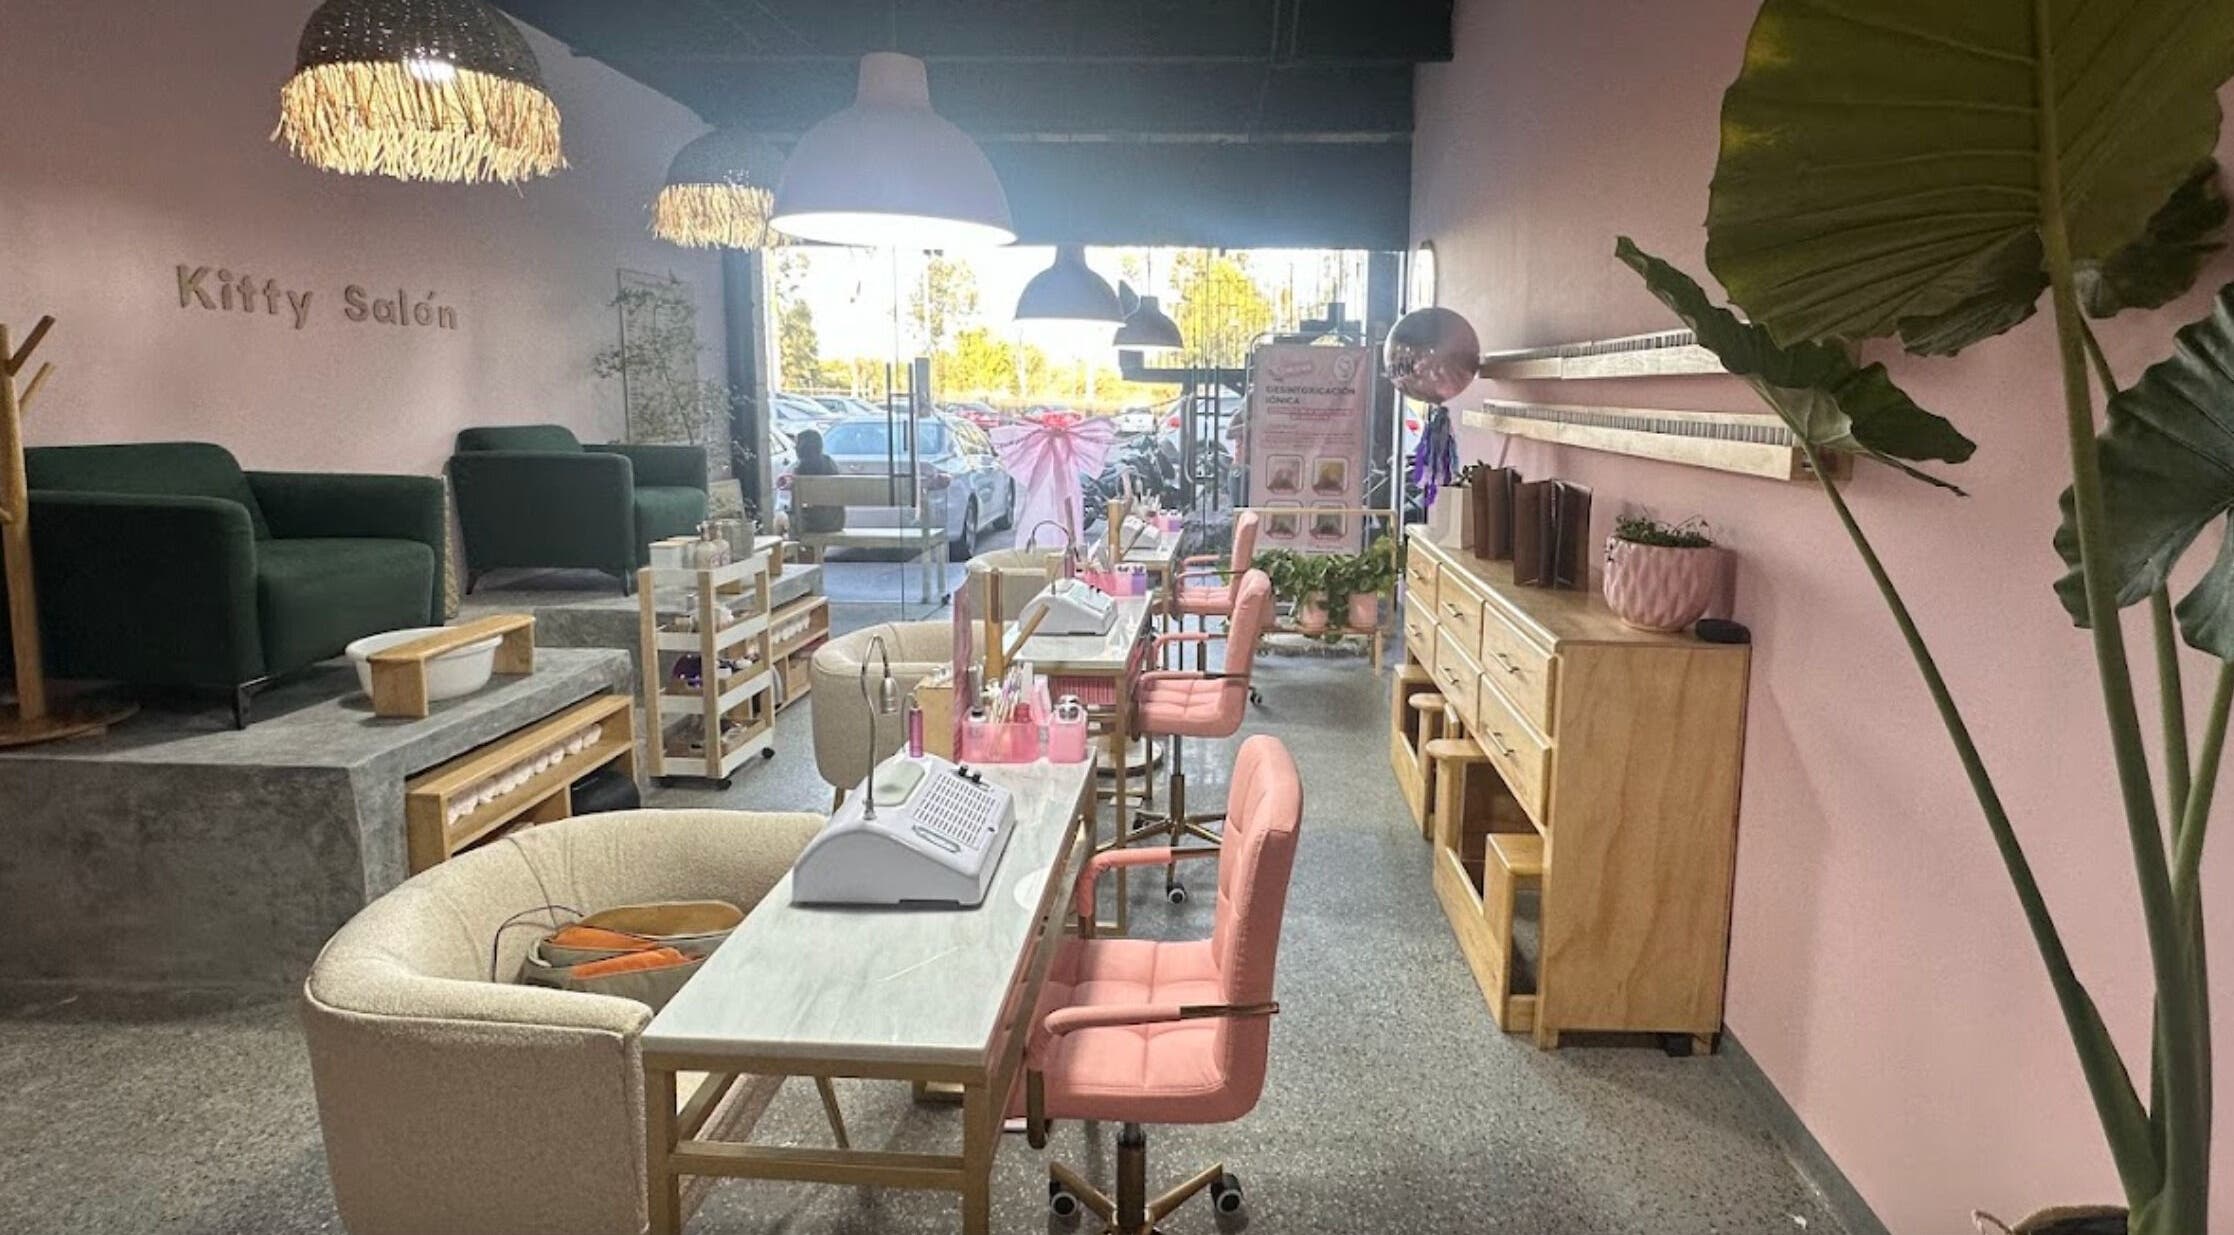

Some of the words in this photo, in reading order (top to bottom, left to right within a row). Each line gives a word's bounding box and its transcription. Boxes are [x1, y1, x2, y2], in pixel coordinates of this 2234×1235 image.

[176, 264, 312, 330] Kitty
[344, 284, 458, 330] Salón
[1265, 385, 1355, 396] DESINTOXICACIÓN
[1265, 395, 1300, 404] IÓNICA
